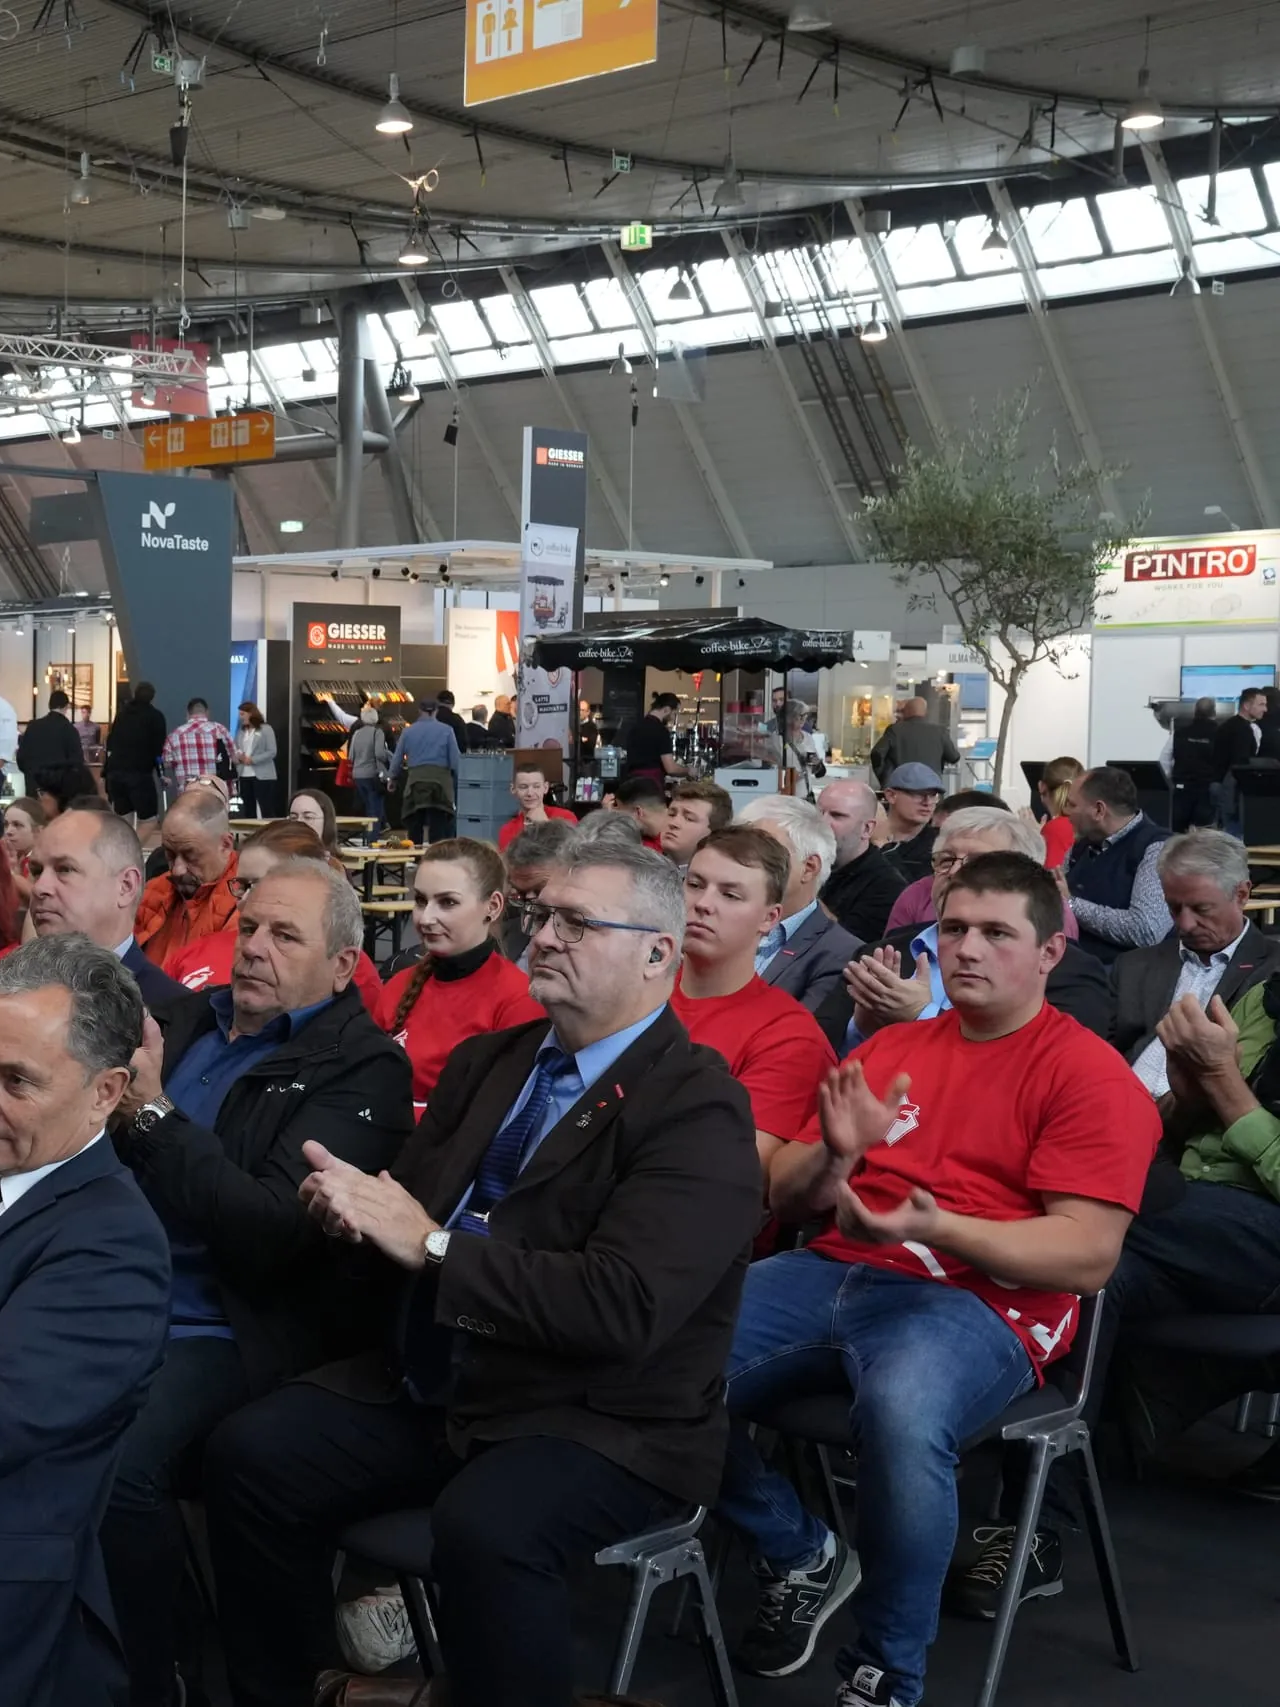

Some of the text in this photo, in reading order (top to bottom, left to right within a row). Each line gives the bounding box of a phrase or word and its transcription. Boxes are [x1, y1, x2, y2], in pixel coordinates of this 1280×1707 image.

[548, 448, 584, 462] GIESSER
[141, 532, 209, 551] NovaTaste
[1132, 549, 1249, 579] PINTRO
[328, 623, 386, 640] GIESSER
[579, 648, 616, 658] coffee-bike
[701, 640, 750, 653] coffee-bike
